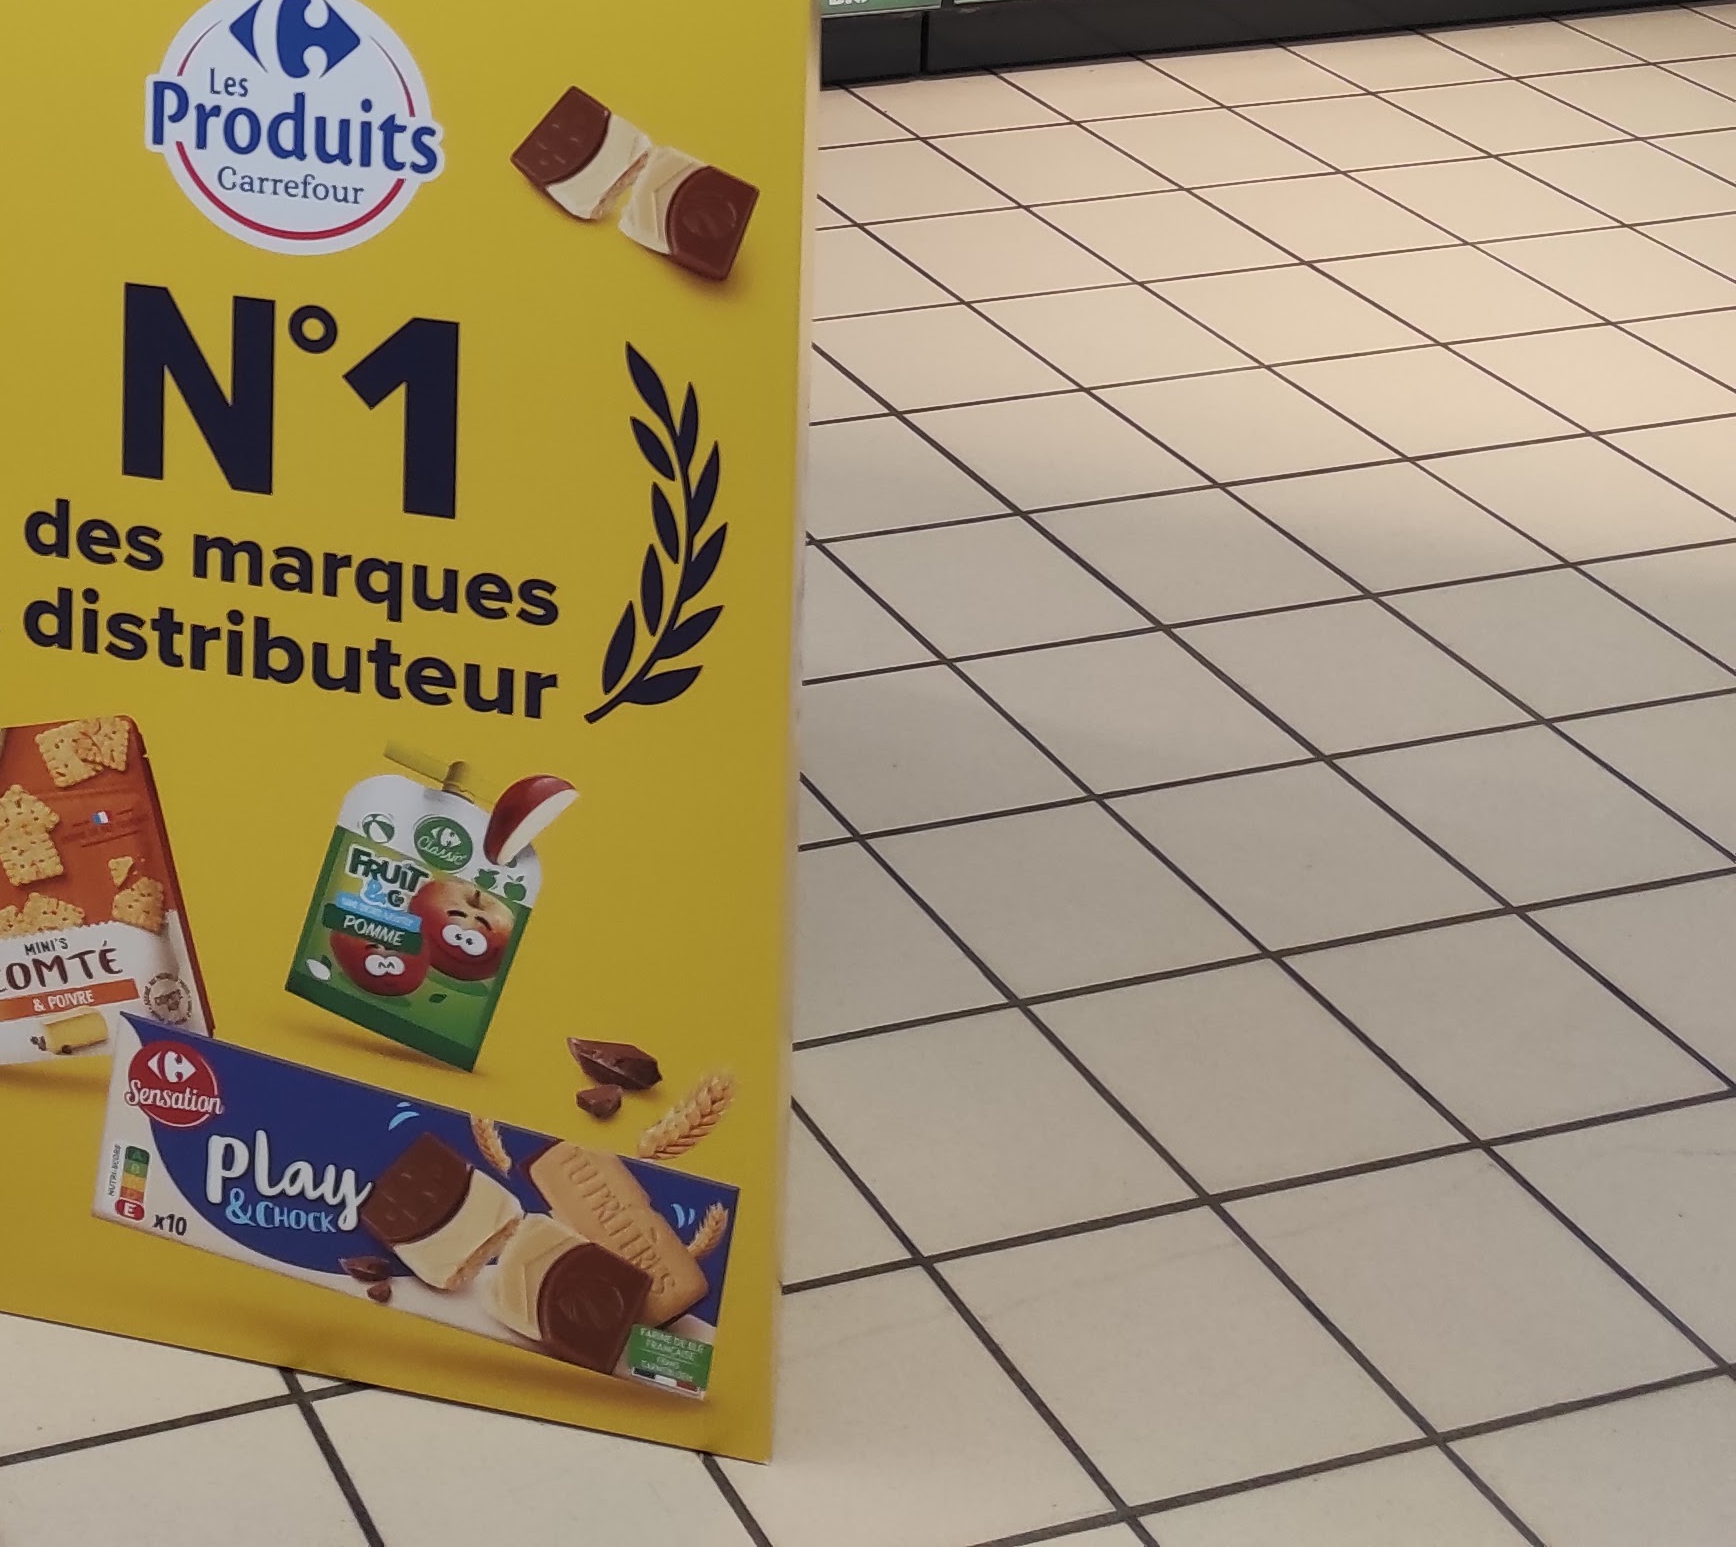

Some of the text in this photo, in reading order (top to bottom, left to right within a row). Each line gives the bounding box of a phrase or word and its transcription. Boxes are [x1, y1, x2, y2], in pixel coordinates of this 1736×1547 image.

[209, 69, 250, 98] Les
[151, 79, 441, 179] Produits
[216, 165, 366, 207] Carrefour
[121, 281, 461, 520] N°1
[22, 497, 561, 629] des marques
[22, 587, 560, 721] distributeur
[342, 914, 406, 946] POMME
[47, 989, 96, 1010] POIVRE
[123, 1077, 225, 1116] Sensation
[152, 1213, 188, 1237] x10
